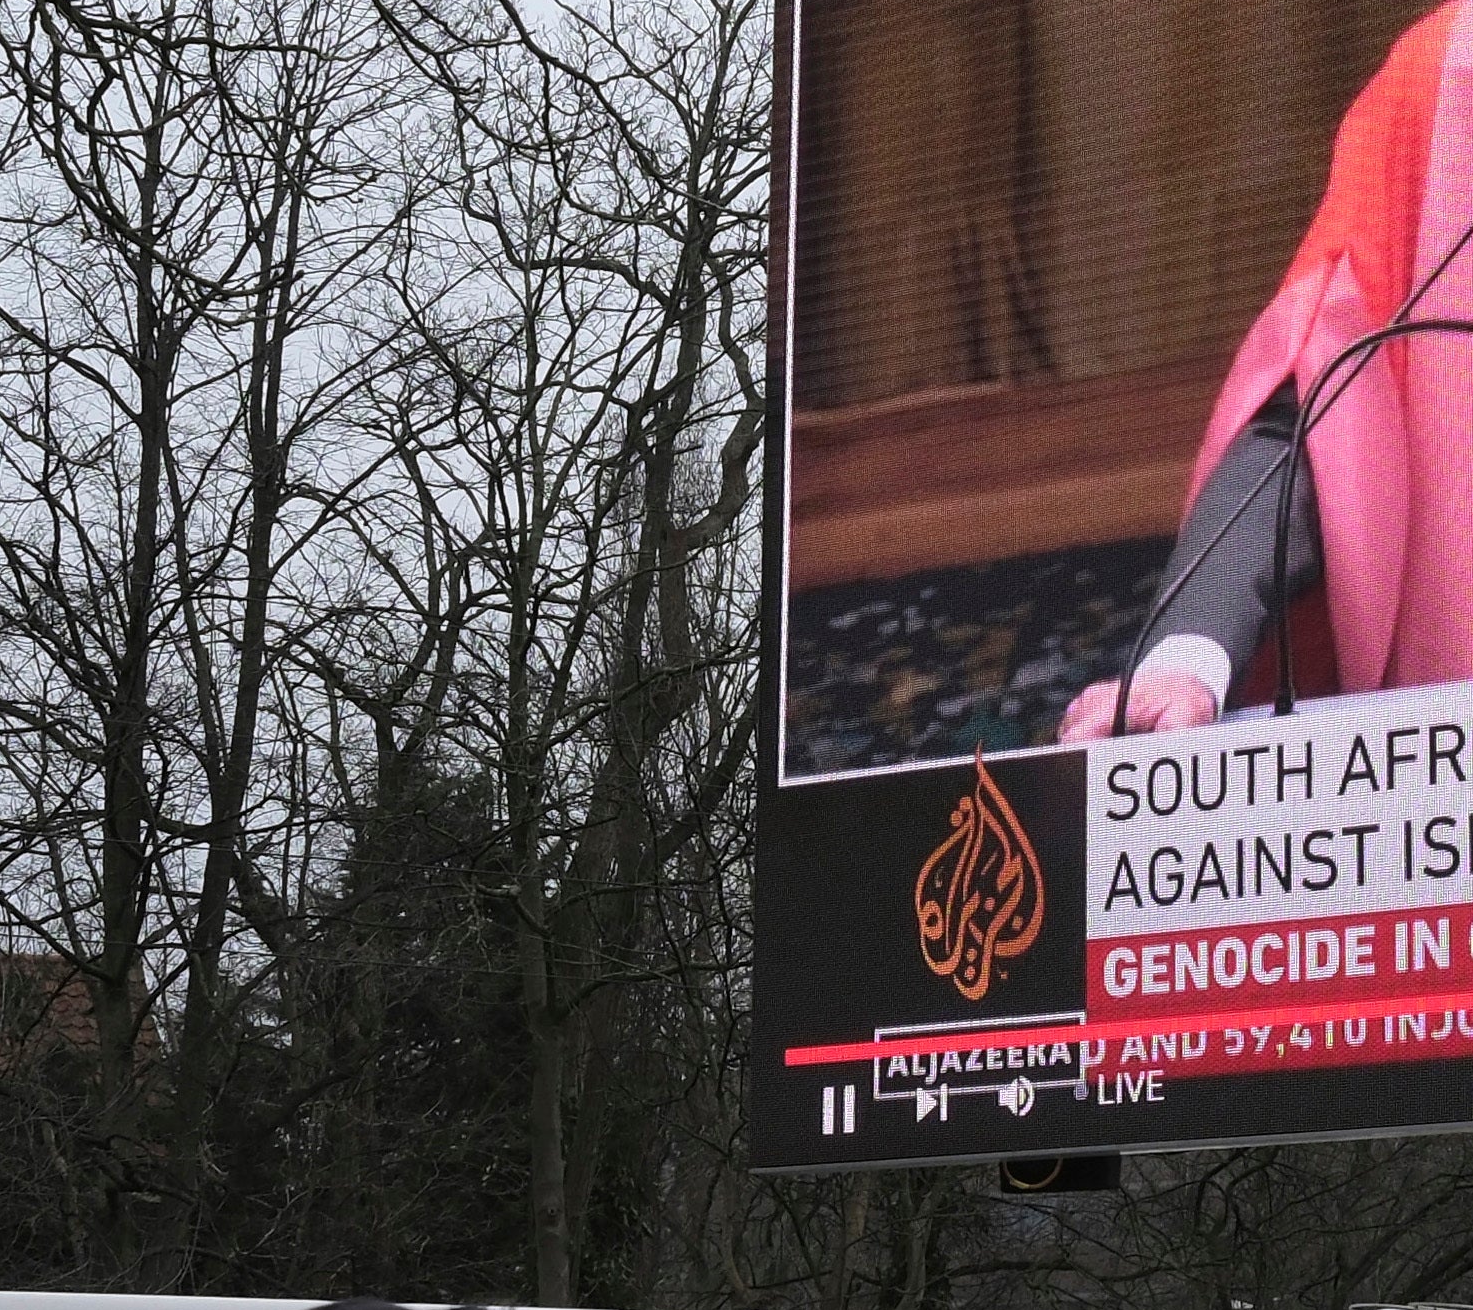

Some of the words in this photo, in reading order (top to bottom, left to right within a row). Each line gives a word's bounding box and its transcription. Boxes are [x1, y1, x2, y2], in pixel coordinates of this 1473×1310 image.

[1105, 741, 1315, 821] SOUTH
[1105, 824, 1381, 912] AGAINST
[1103, 925, 1377, 998] GENOCIDE
[1396, 919, 1450, 971] IN
[1121, 1029, 1207, 1063] AND
[1098, 1069, 1166, 1105] LIVE
